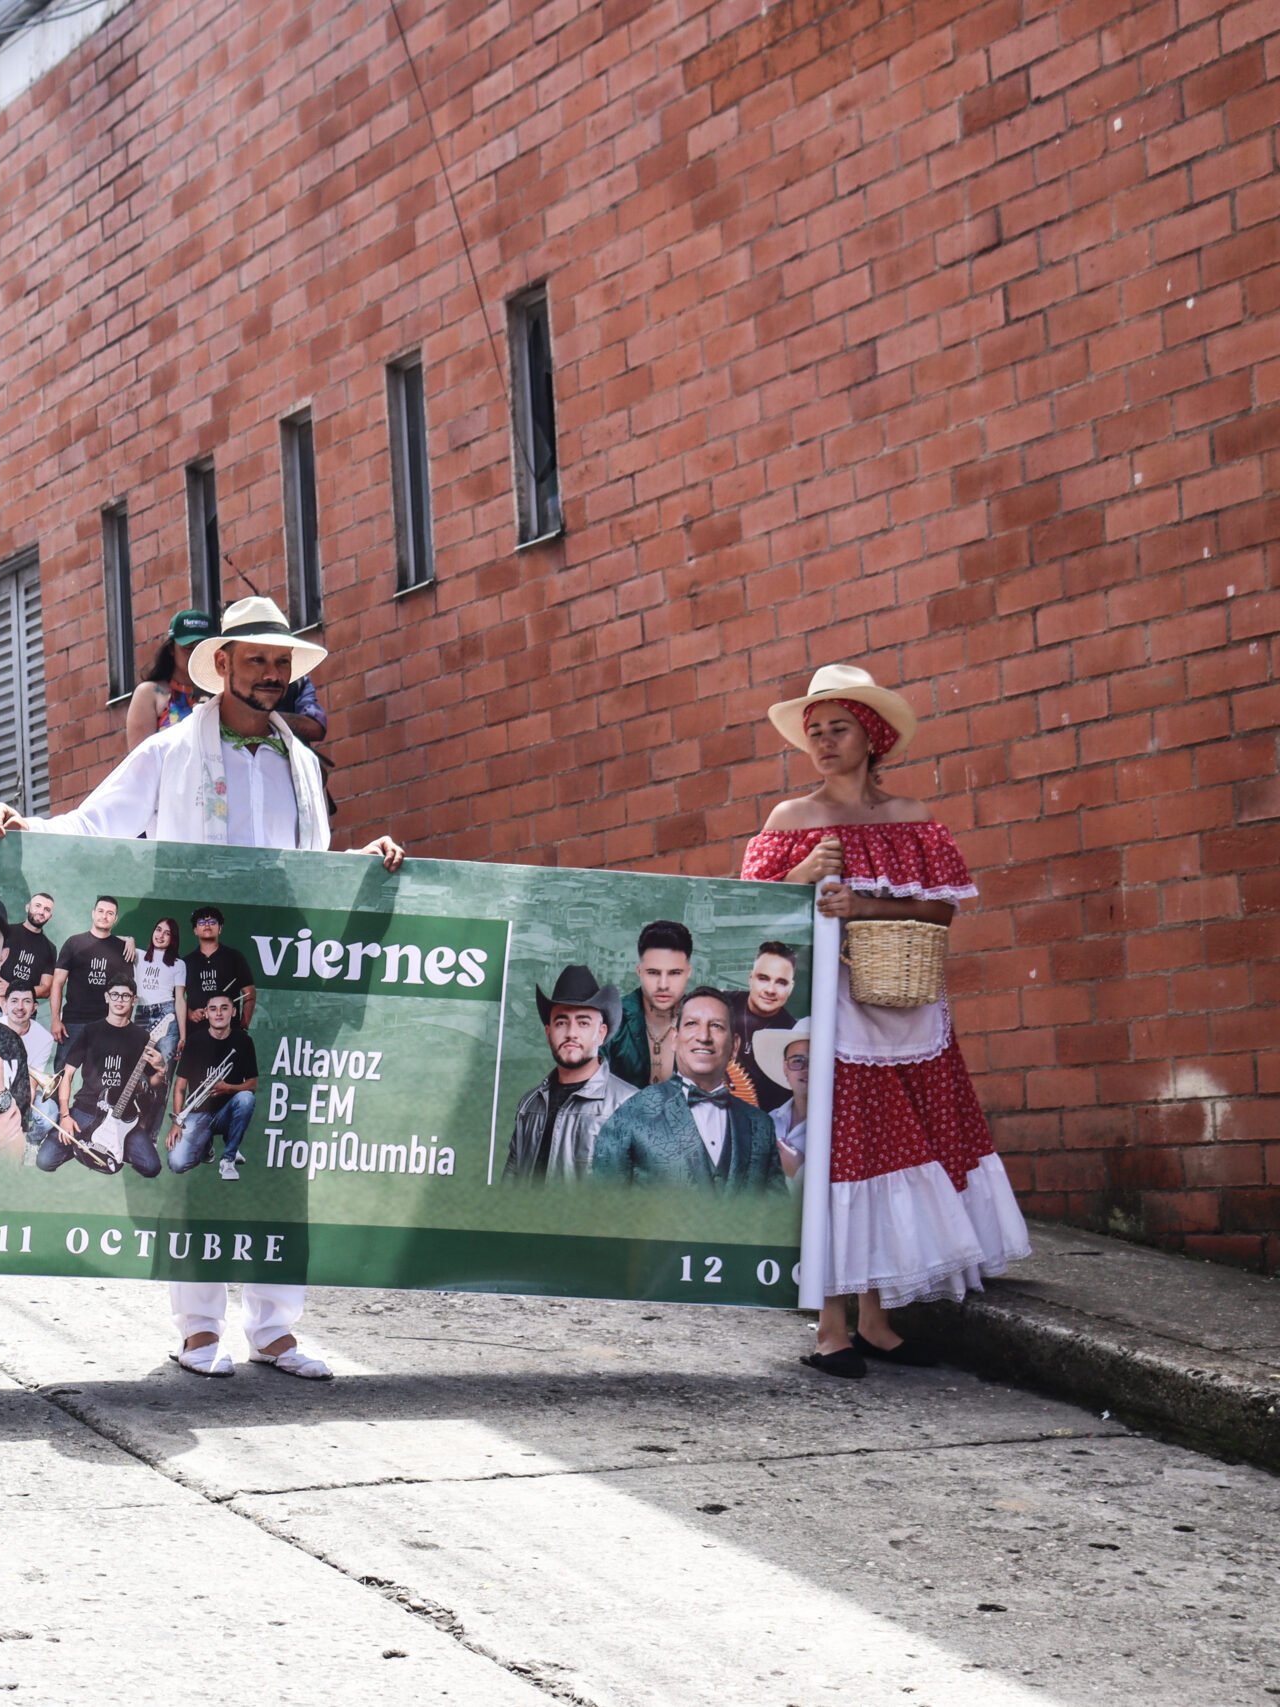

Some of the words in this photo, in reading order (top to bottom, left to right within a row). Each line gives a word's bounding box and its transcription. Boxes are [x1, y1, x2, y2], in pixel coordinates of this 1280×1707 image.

[14, 963, 31, 974] ALTA
[102, 1071, 121, 1079] ALTA
[271, 1036, 382, 1080] Altavoz
[268, 1082, 355, 1124] B-EM
[264, 1128, 455, 1180] TropiQumbia
[65, 1227, 285, 1263] OCTUBRE
[680, 1255, 724, 1284] 12
